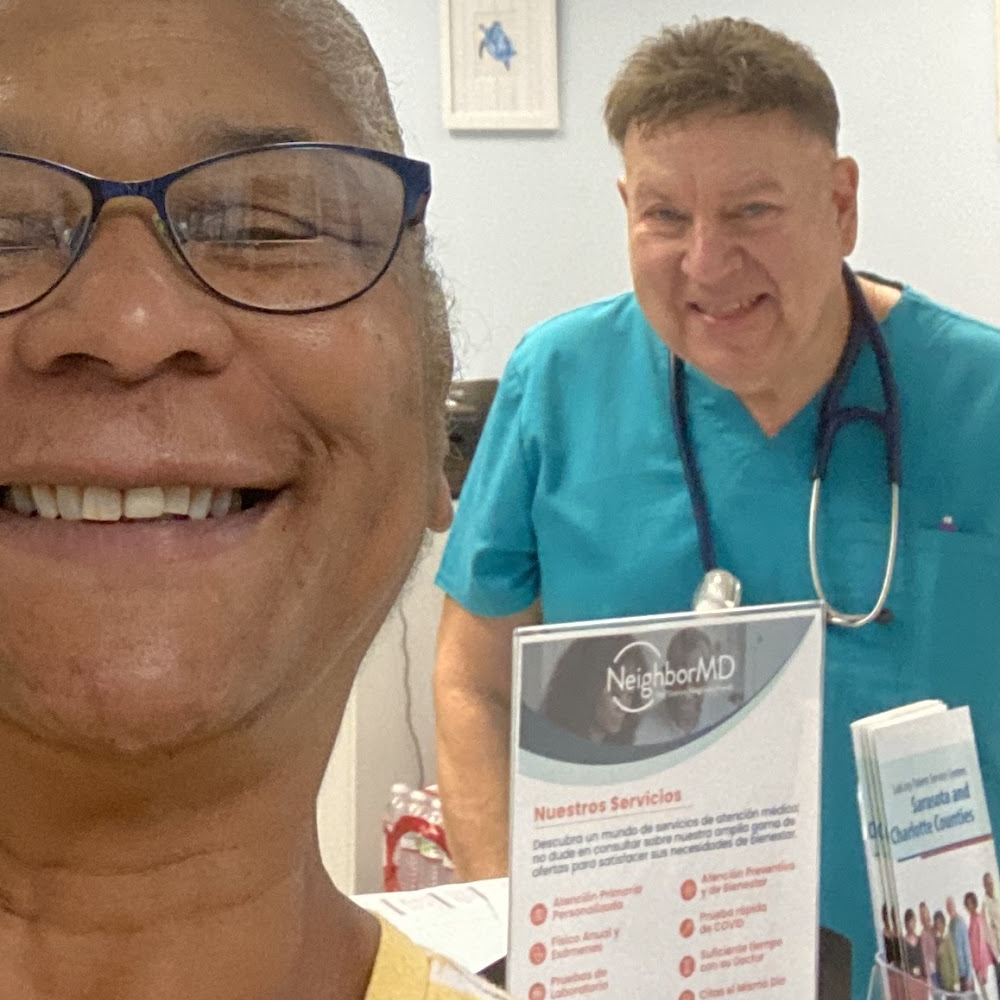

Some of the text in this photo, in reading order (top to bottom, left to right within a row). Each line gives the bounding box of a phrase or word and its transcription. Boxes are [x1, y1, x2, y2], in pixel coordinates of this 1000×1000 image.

[606, 654, 736, 699] NeighborMD
[534, 788, 682, 821] Nuestros Servicios
[952, 781, 971, 801] and
[532, 834, 583, 850] Descubra
[585, 832, 599, 843] un
[601, 825, 638, 839] mundo
[640, 823, 653, 835] de
[655, 817, 699, 832] servicios
[701, 814, 714, 826] de
[532, 854, 546, 864] no
[548, 848, 575, 861] dude
[578, 846, 591, 857] en
[593, 839, 642, 854] consultar
[643, 833, 673, 847] sobre
[674, 828, 713, 842] nuestra
[751, 819, 781, 834] gama
[783, 816, 795, 828] de
[891, 820, 934, 843] Charlotte
[934, 807, 975, 830] Counties
[532, 863, 569, 877] ofertas
[571, 859, 597, 874] para
[651, 848, 668, 859] sus
[670, 838, 733, 855] necesidades
[735, 836, 748, 847] de
